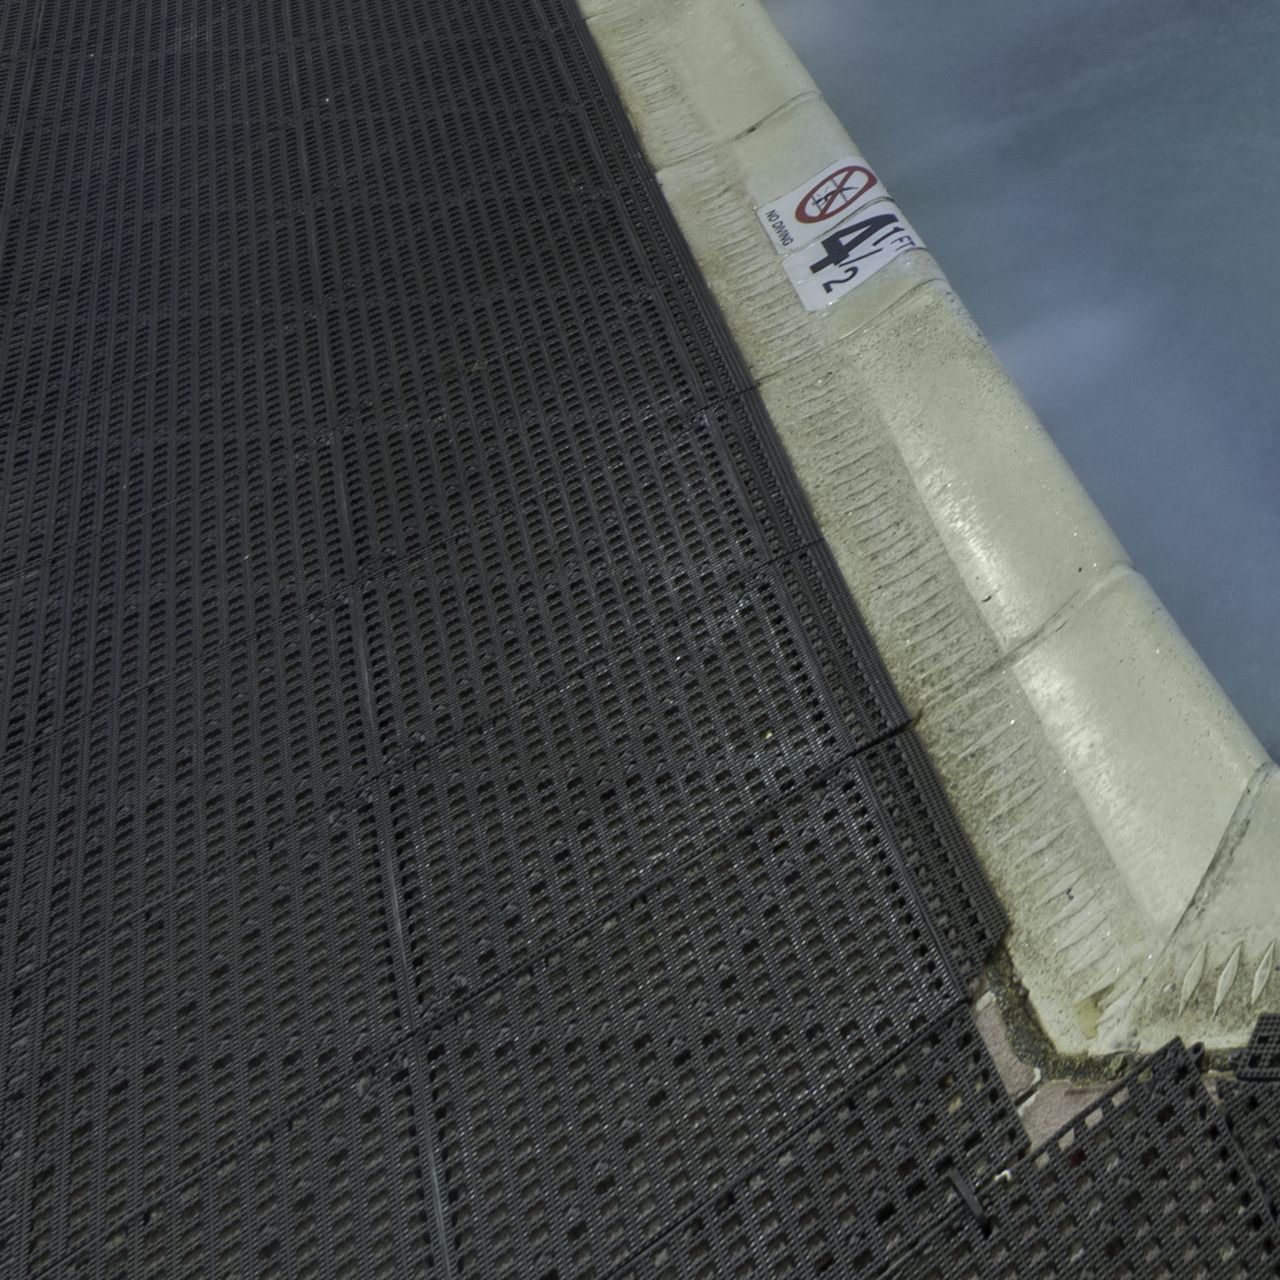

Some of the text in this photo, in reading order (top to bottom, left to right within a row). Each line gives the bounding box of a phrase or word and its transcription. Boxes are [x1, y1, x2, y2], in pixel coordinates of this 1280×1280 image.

[765, 209, 794, 246] NO DIVING
[809, 214, 899, 274] 4
[891, 235, 916, 253] FT
